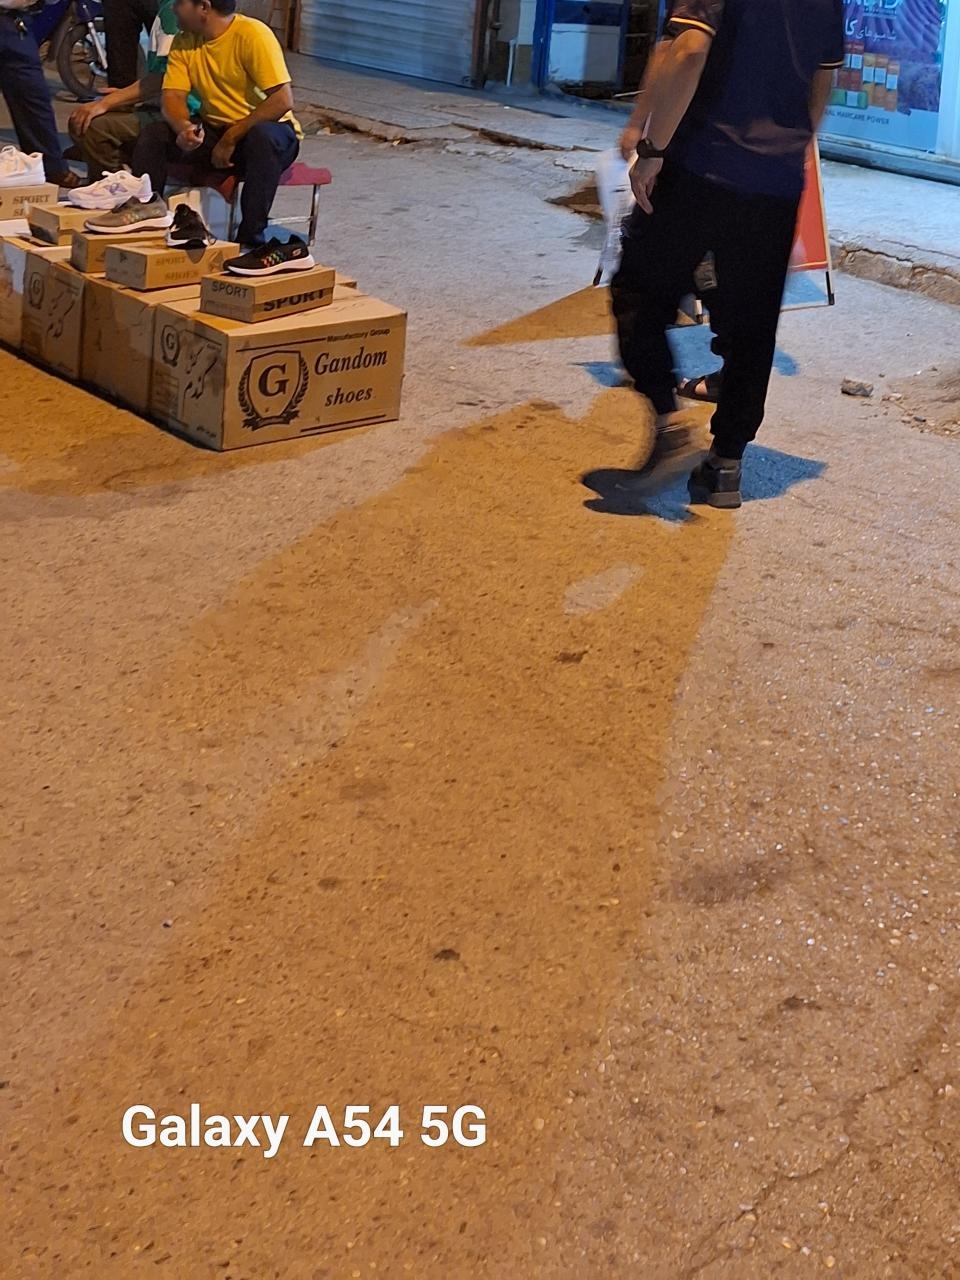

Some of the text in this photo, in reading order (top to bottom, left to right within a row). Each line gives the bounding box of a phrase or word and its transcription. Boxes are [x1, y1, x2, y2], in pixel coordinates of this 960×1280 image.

[211, 280, 248, 299] SPORT
[314, 345, 389, 376] Gandom
[258, 362, 290, 398] G
[324, 386, 373, 408] shoes
